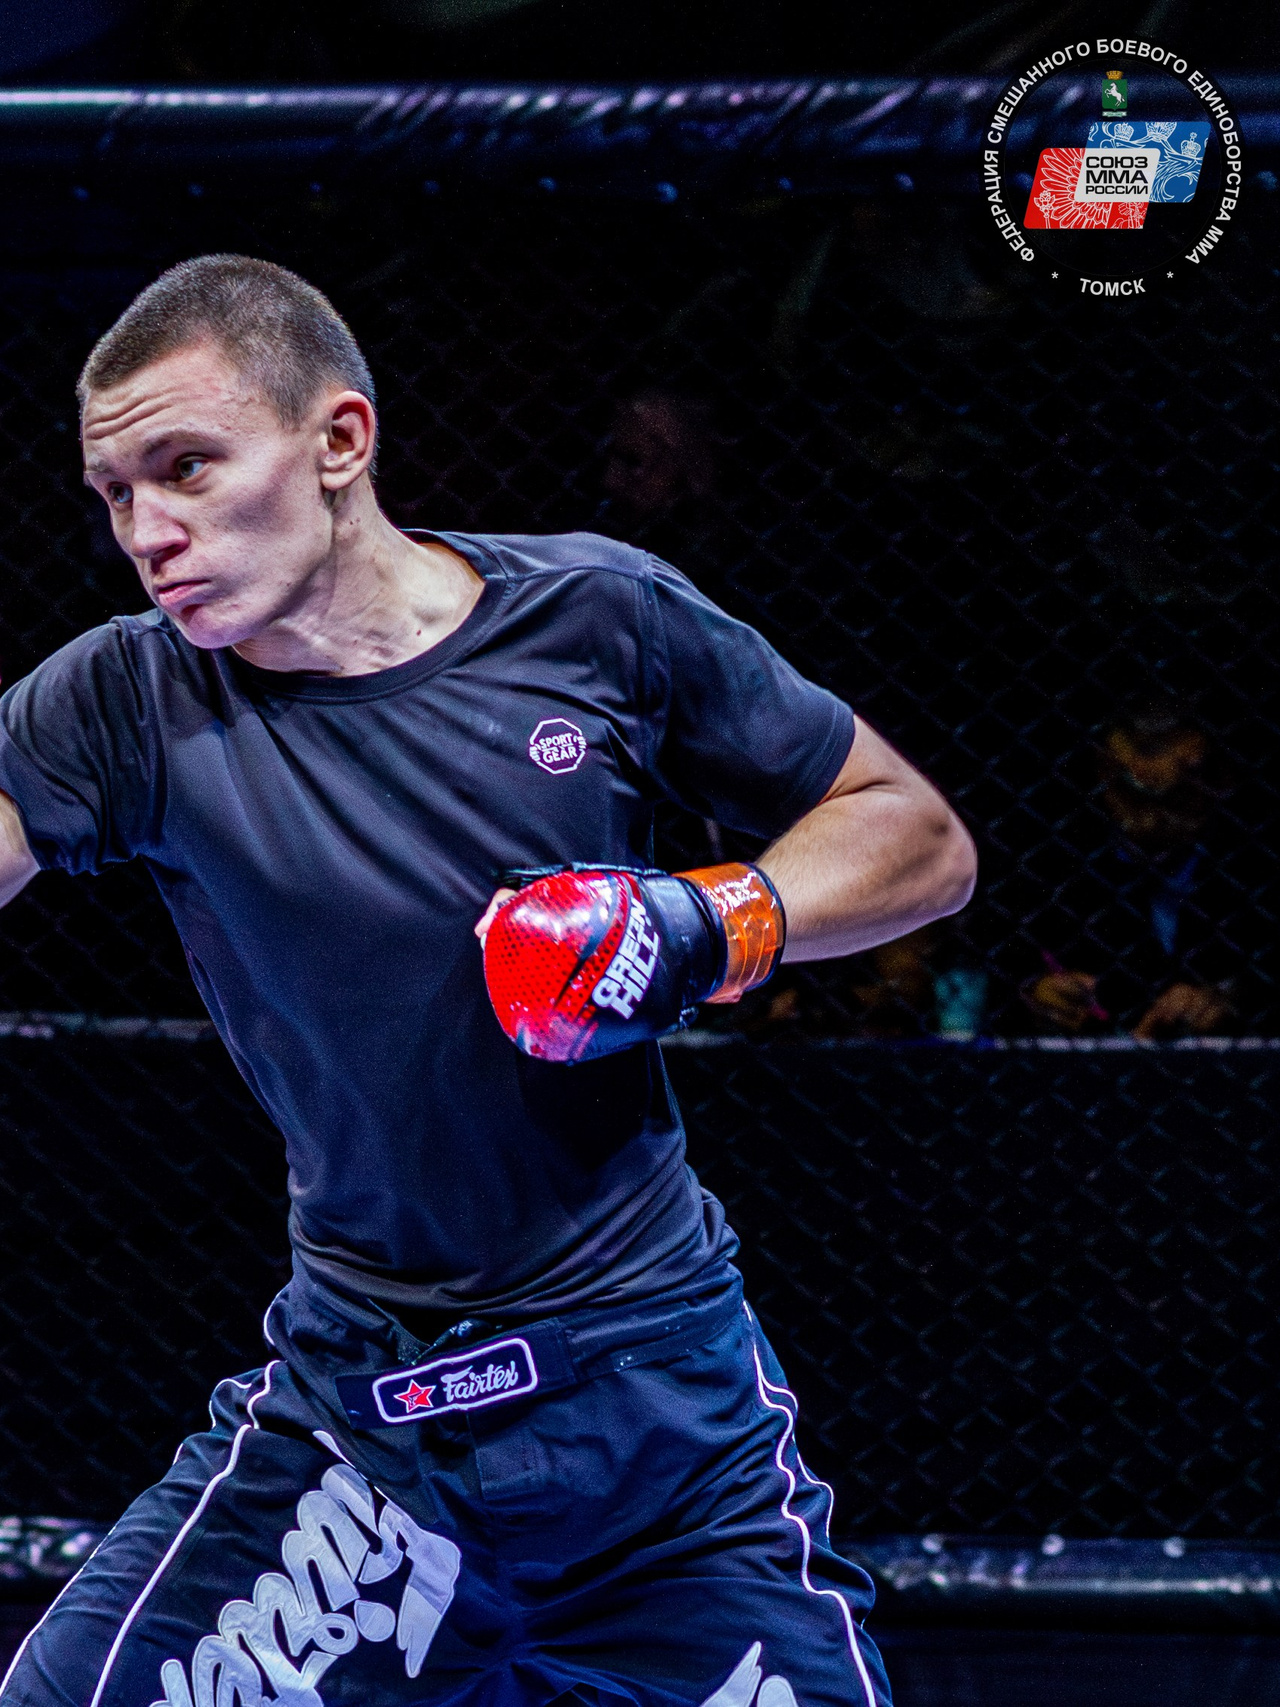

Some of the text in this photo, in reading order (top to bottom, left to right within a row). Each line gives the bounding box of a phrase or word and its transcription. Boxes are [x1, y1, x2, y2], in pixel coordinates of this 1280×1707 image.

[539, 733, 573, 749] SPORT
[542, 746, 578, 764] GEAR
[440, 1360, 519, 1402] Fairtex
